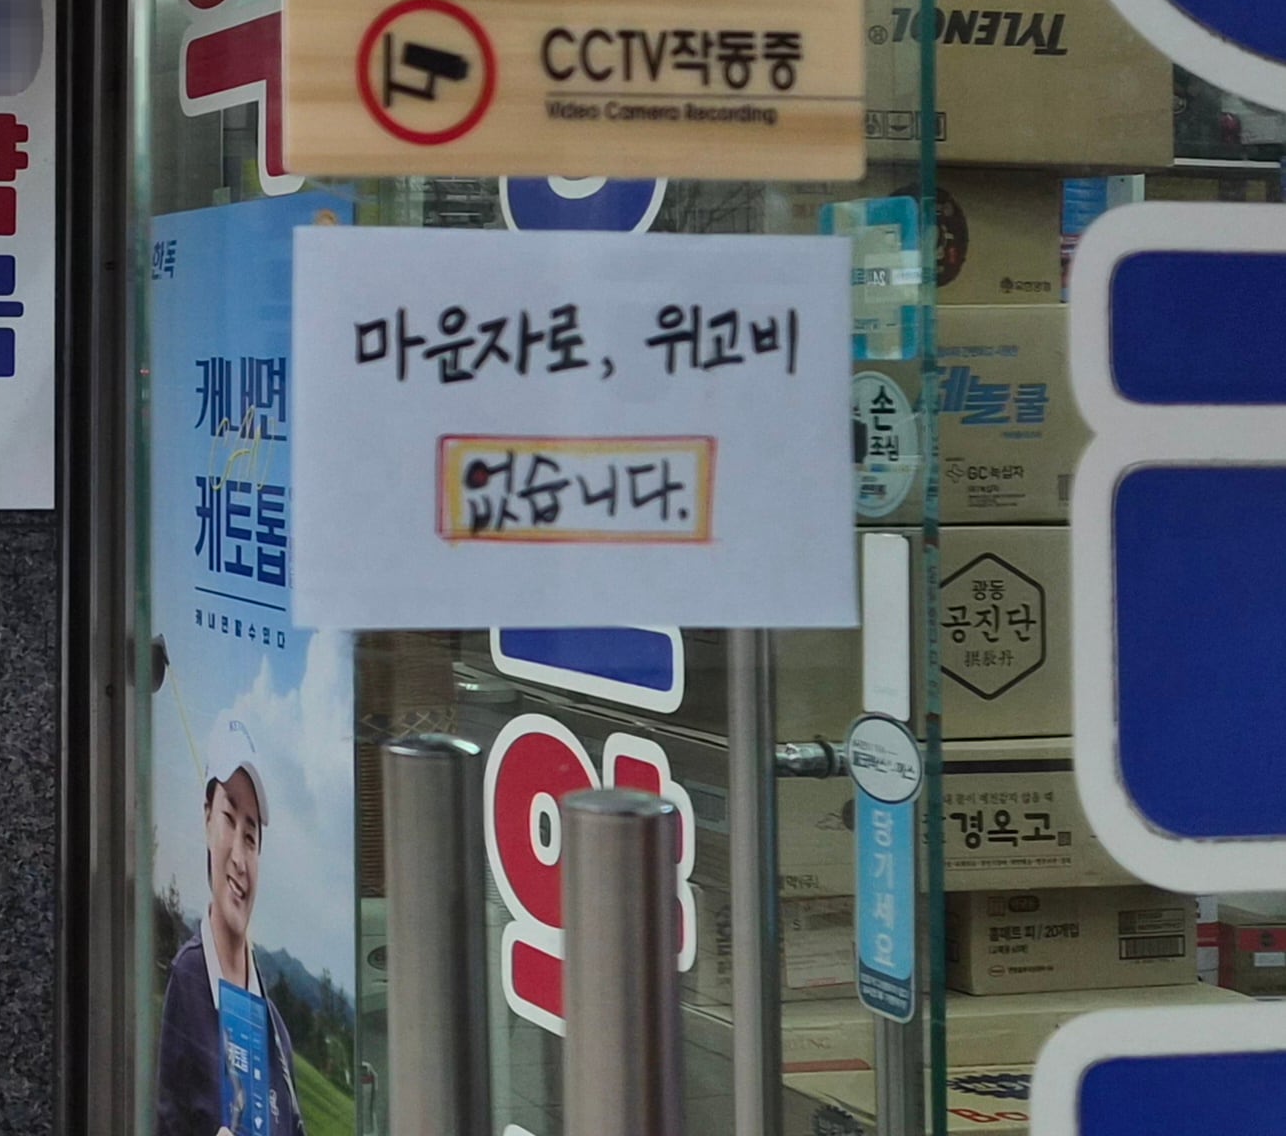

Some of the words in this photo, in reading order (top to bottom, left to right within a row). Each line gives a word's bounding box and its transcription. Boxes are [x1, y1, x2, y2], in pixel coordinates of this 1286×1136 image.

[539, 28, 803, 90] CCTV작동중
[545, 101, 600, 121] Video
[605, 102, 680, 122] Camera
[684, 103, 778, 126] Recording
[354, 304, 614, 383] 마운자로,
[646, 306, 799, 375] 위고비
[870, 385, 896, 431] 손
[869, 435, 899, 462] 조심
[463, 450, 691, 535] 없습니다.
[194, 476, 288, 588] 케토톱
[971, 581, 1005, 601] 광동
[941, 604, 1037, 643] 공진단
[949, 809, 1056, 850] 경옥고
